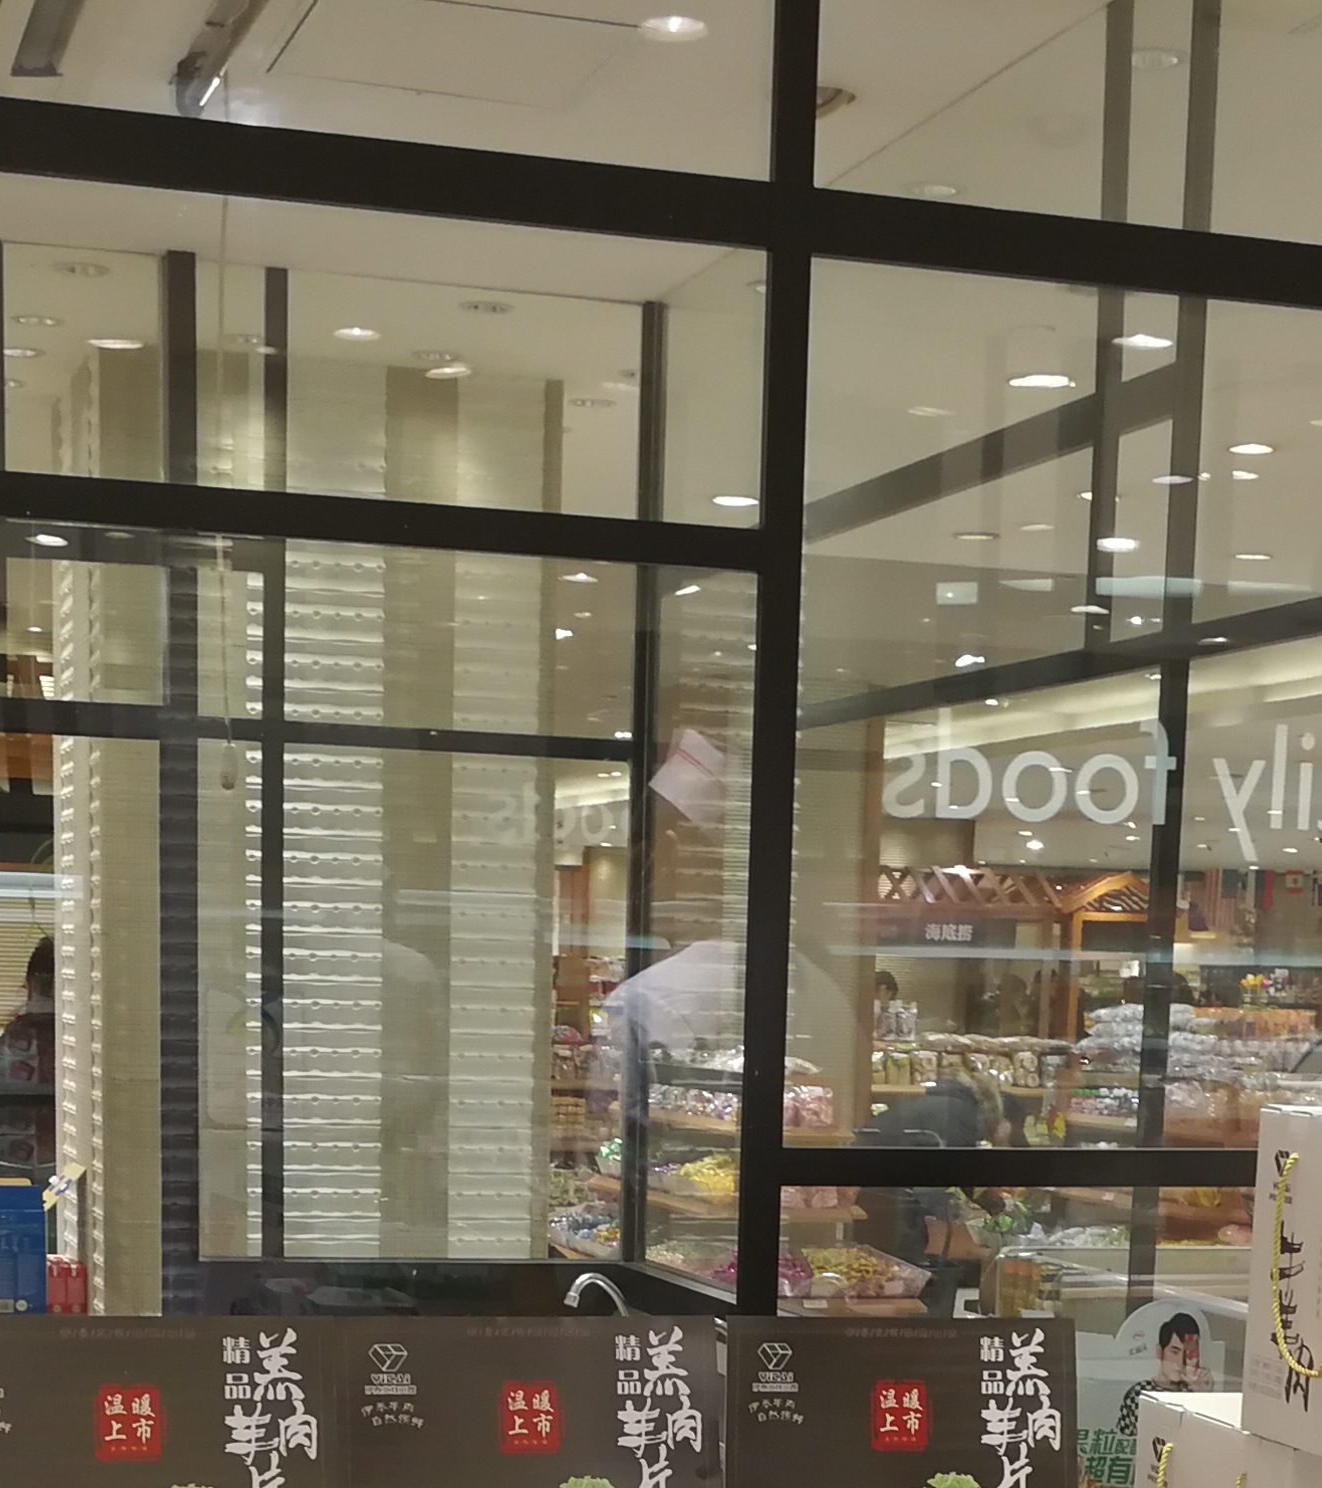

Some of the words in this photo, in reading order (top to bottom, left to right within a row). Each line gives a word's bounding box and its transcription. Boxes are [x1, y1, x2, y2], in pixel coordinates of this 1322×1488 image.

[925, 923, 973, 942] 海底捞
[222, 1336, 251, 1400] 精品
[614, 1335, 643, 1396] 精品
[979, 1336, 1005, 1395] 精品
[104, 1393, 155, 1417] 温暖
[507, 1390, 556, 1413] 温暖
[879, 1388, 924, 1411] 温暖
[104, 1419, 154, 1444] 上市
[507, 1413, 554, 1438] 上市
[879, 1411, 923, 1435] 上市
[1084, 1456, 1135, 1486] 超有
